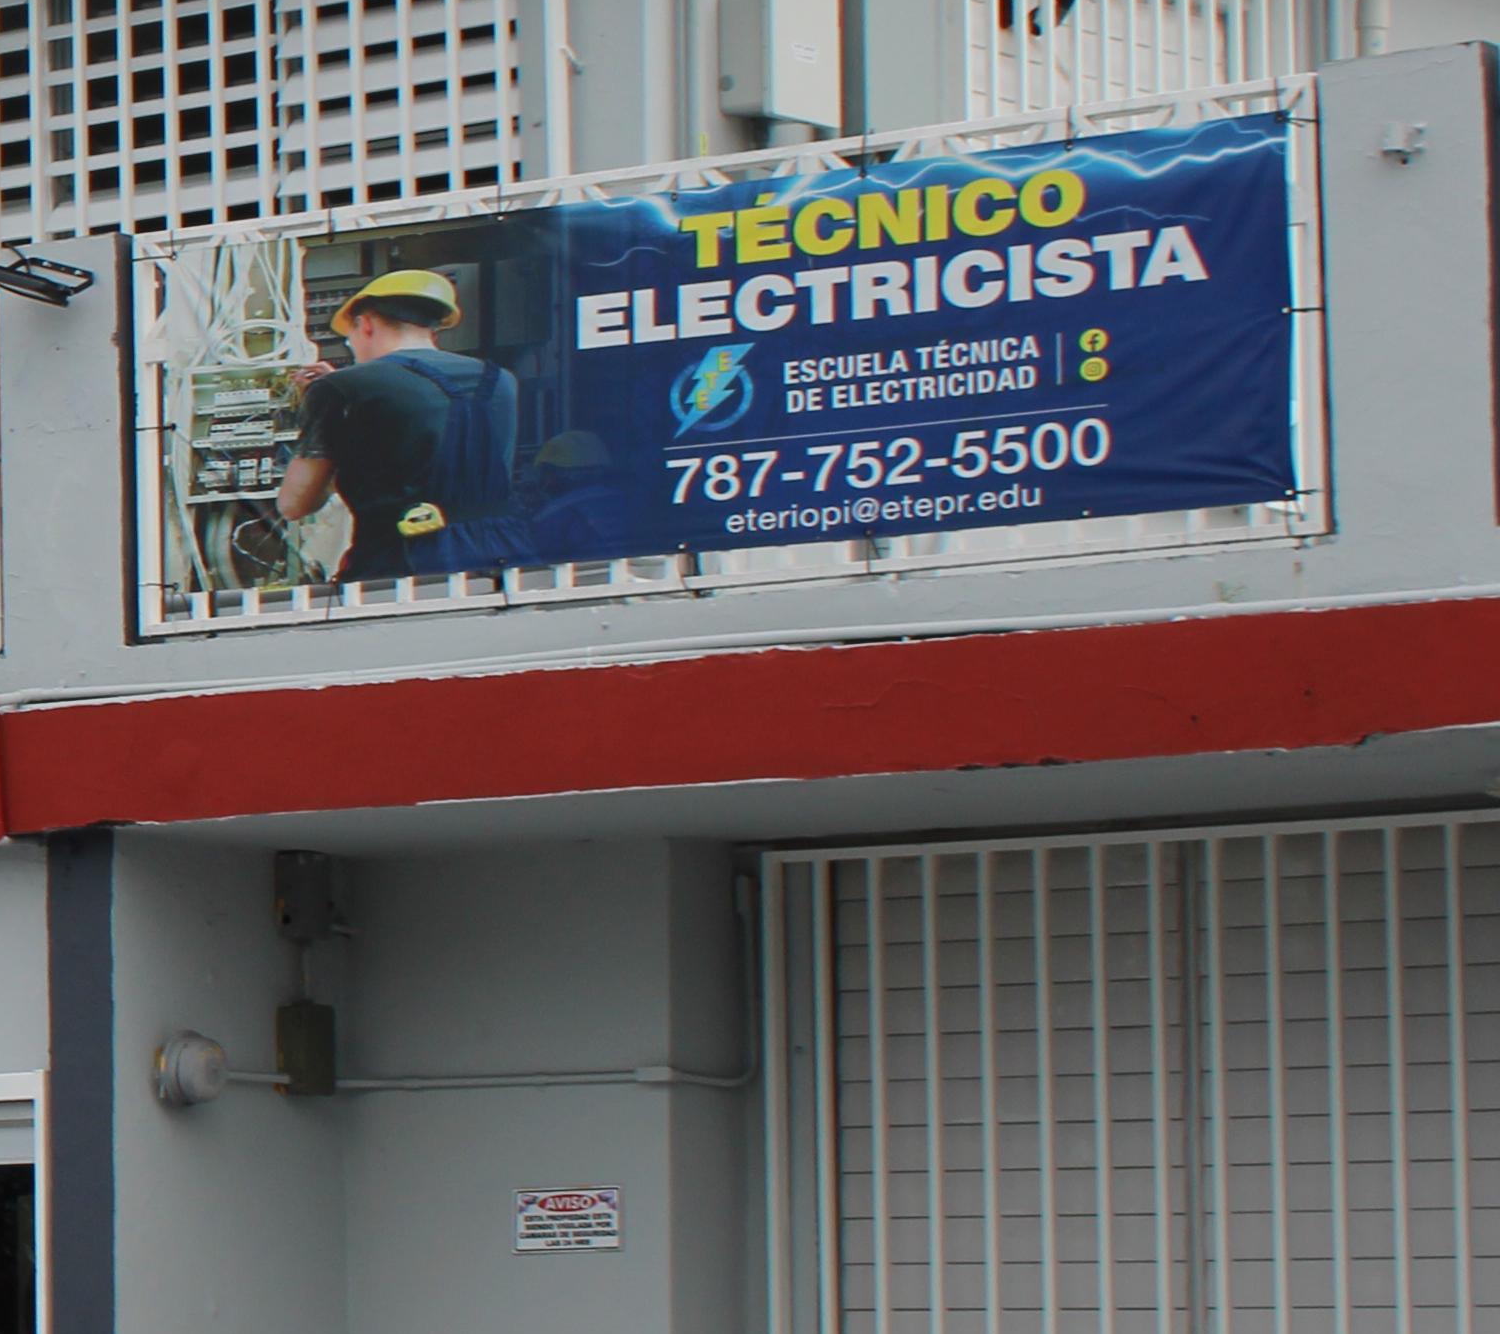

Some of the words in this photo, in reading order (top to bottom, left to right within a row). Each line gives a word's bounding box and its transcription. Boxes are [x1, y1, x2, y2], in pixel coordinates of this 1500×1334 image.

[678, 169, 1086, 269] TÉCNICO
[576, 224, 1209, 351] ELECTRICISTA
[783, 350, 908, 386] ESCUELA
[916, 335, 1041, 371] TÉCNICA
[786, 387, 823, 414] DE
[832, 365, 1037, 409] ELECTRICIDAD
[666, 417, 1112, 505] 787-752-5500
[725, 483, 1043, 534] eteriopi@etepr.edu
[545, 1195, 591, 1210] AVISO
